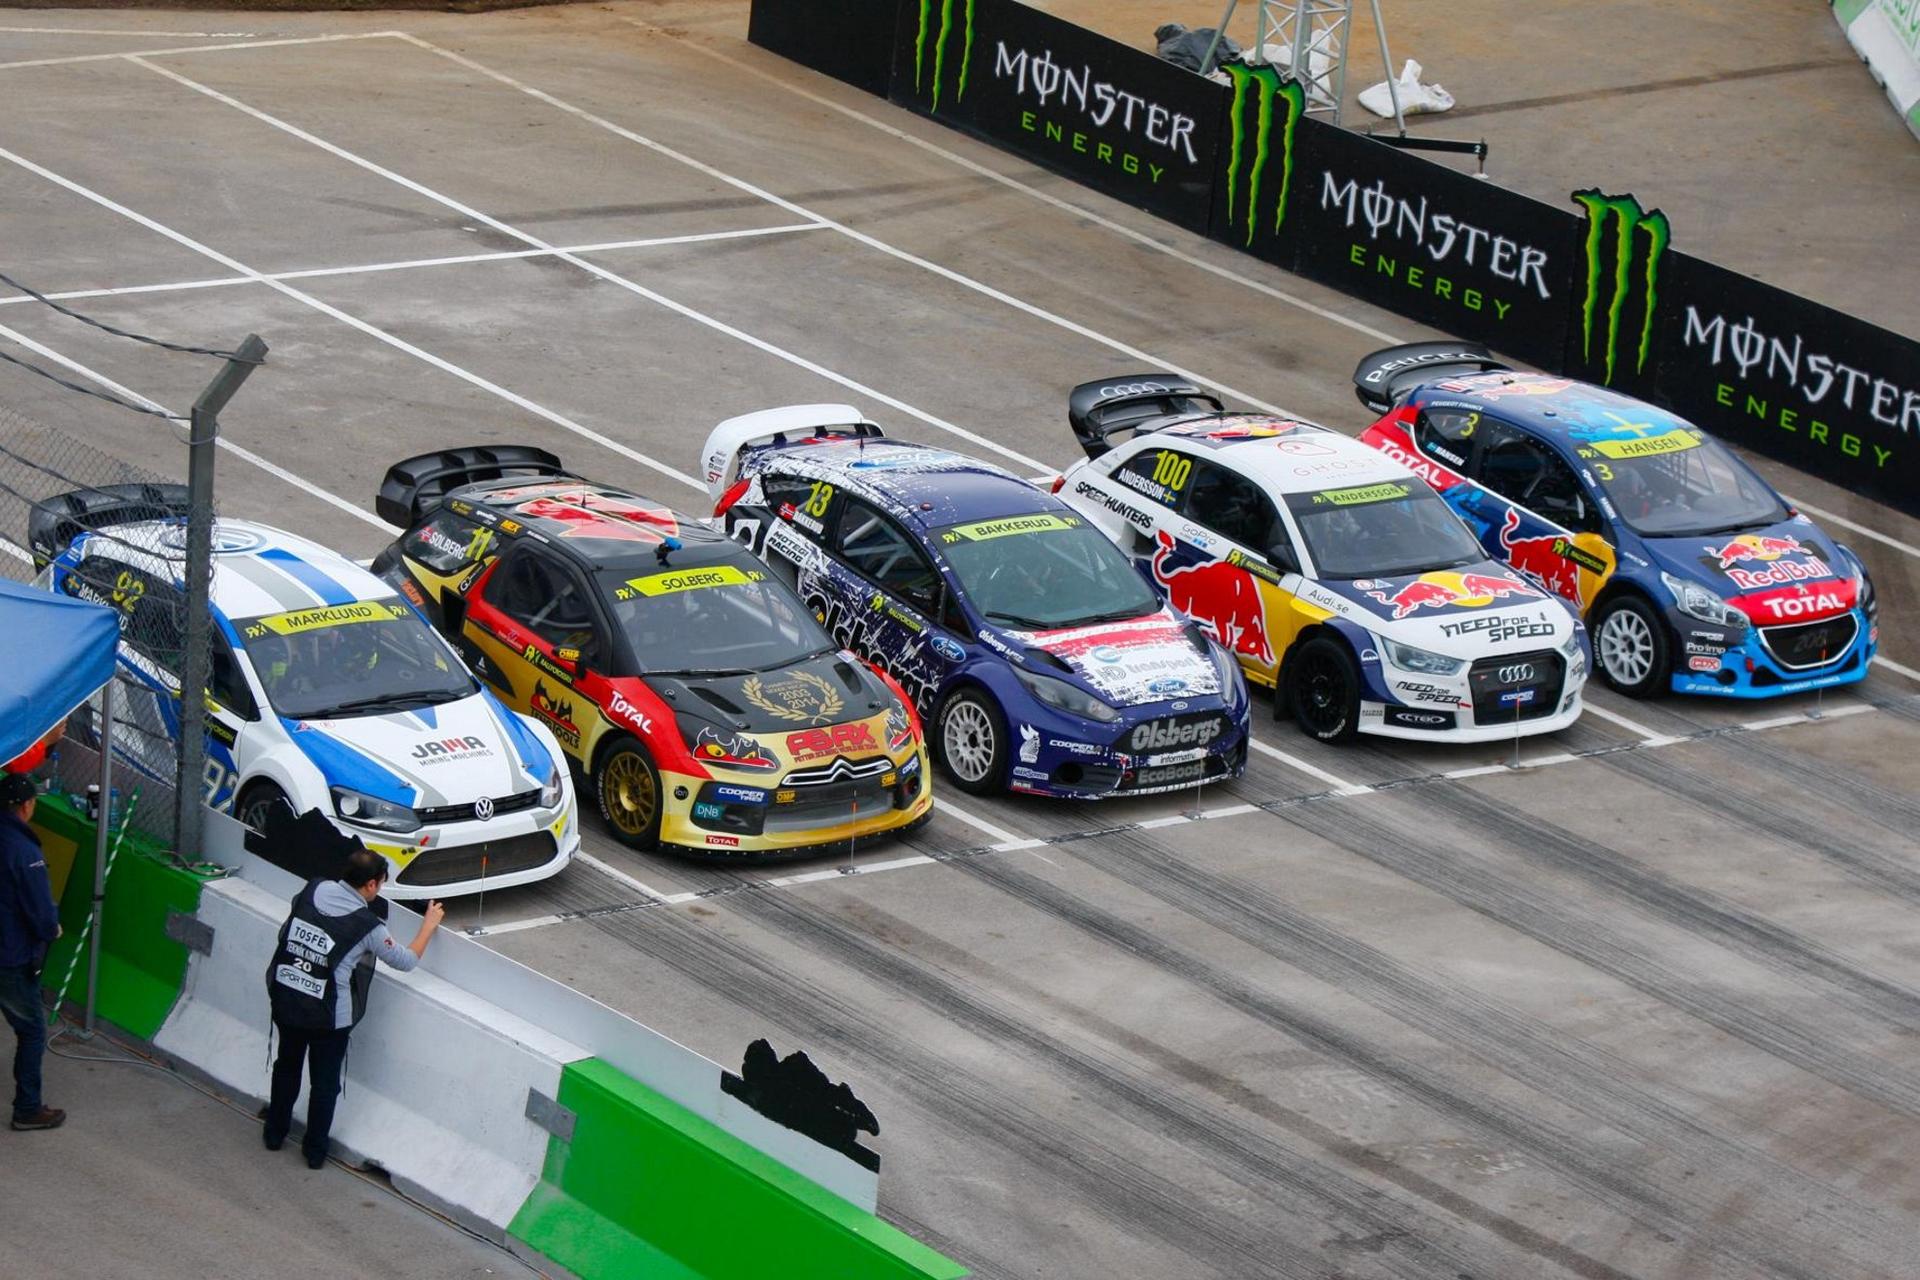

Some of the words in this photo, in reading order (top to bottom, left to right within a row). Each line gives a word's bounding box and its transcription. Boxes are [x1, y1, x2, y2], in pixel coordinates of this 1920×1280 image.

[995, 41, 1198, 164] MONSTER
[1022, 111, 1164, 183] ENERGY
[1320, 170, 1551, 299] MONSTER
[1350, 244, 1511, 320] ENERGY
[1459, 412, 1479, 437] 3
[1716, 383, 1892, 468] ENERGY
[1621, 438, 1681, 455] HANSEN
[1152, 449, 1192, 491] 100
[1379, 439, 1444, 487] TOTAL
[1594, 463, 1614, 481] 3
[1117, 468, 1166, 500] ANDERSSON
[1333, 487, 1398, 502] ANDERSSON
[804, 482, 833, 518] 13
[975, 519, 1052, 536] BAKKERUD
[429, 532, 467, 560] SOLBERG
[465, 526, 494, 561] 11
[768, 537, 804, 563] RACING
[773, 531, 810, 558] MOTEGI
[661, 573, 724, 590] SOLBERG
[1725, 562, 1786, 589] Red
[1781, 556, 1833, 580] Bull
[112, 571, 145, 613] 92
[1309, 589, 1350, 614] Audi.se
[286, 607, 372, 628] MARKLUND
[1763, 593, 1846, 619] TOTAL
[1488, 623, 1555, 643] SPEED
[1502, 617, 1529, 627] FOR
[1415, 692, 1462, 704] SPEED
[609, 691, 652, 734] TOTAL
[1049, 739, 1095, 751] COOPER
[1131, 718, 1222, 750] Olsbergs
[419, 754, 451, 768] MINING
[1137, 762, 1206, 784] EcoBoost
[718, 786, 765, 797] COOPER
[697, 804, 719, 818] DNB
[708, 836, 737, 845] TOTAL
[293, 957, 313, 973] 20
